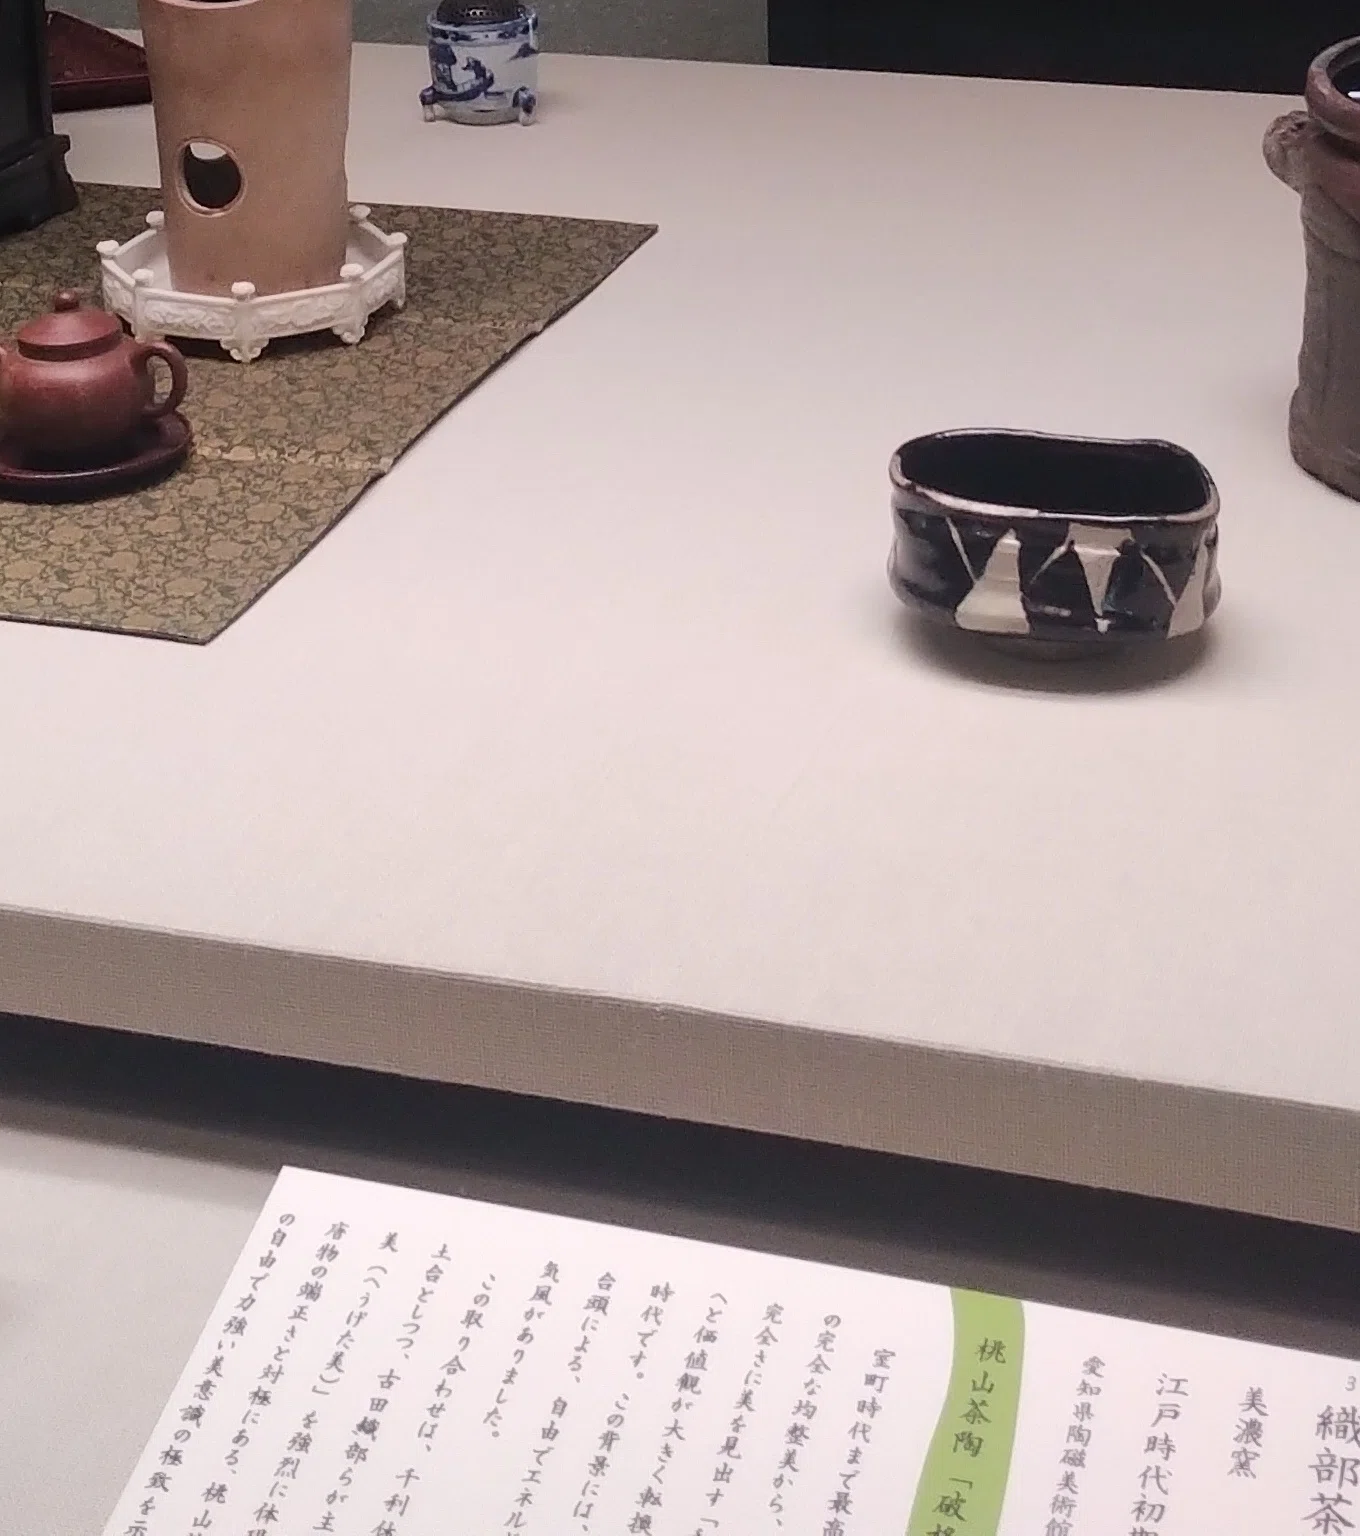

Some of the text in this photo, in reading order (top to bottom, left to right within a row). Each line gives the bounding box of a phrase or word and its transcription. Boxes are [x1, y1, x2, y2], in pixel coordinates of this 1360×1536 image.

[482, 1260, 560, 1438] 気風がありました。
[1345, 1375, 1357, 1392] 3
[1227, 1386, 1269, 1479] 美濃窯
